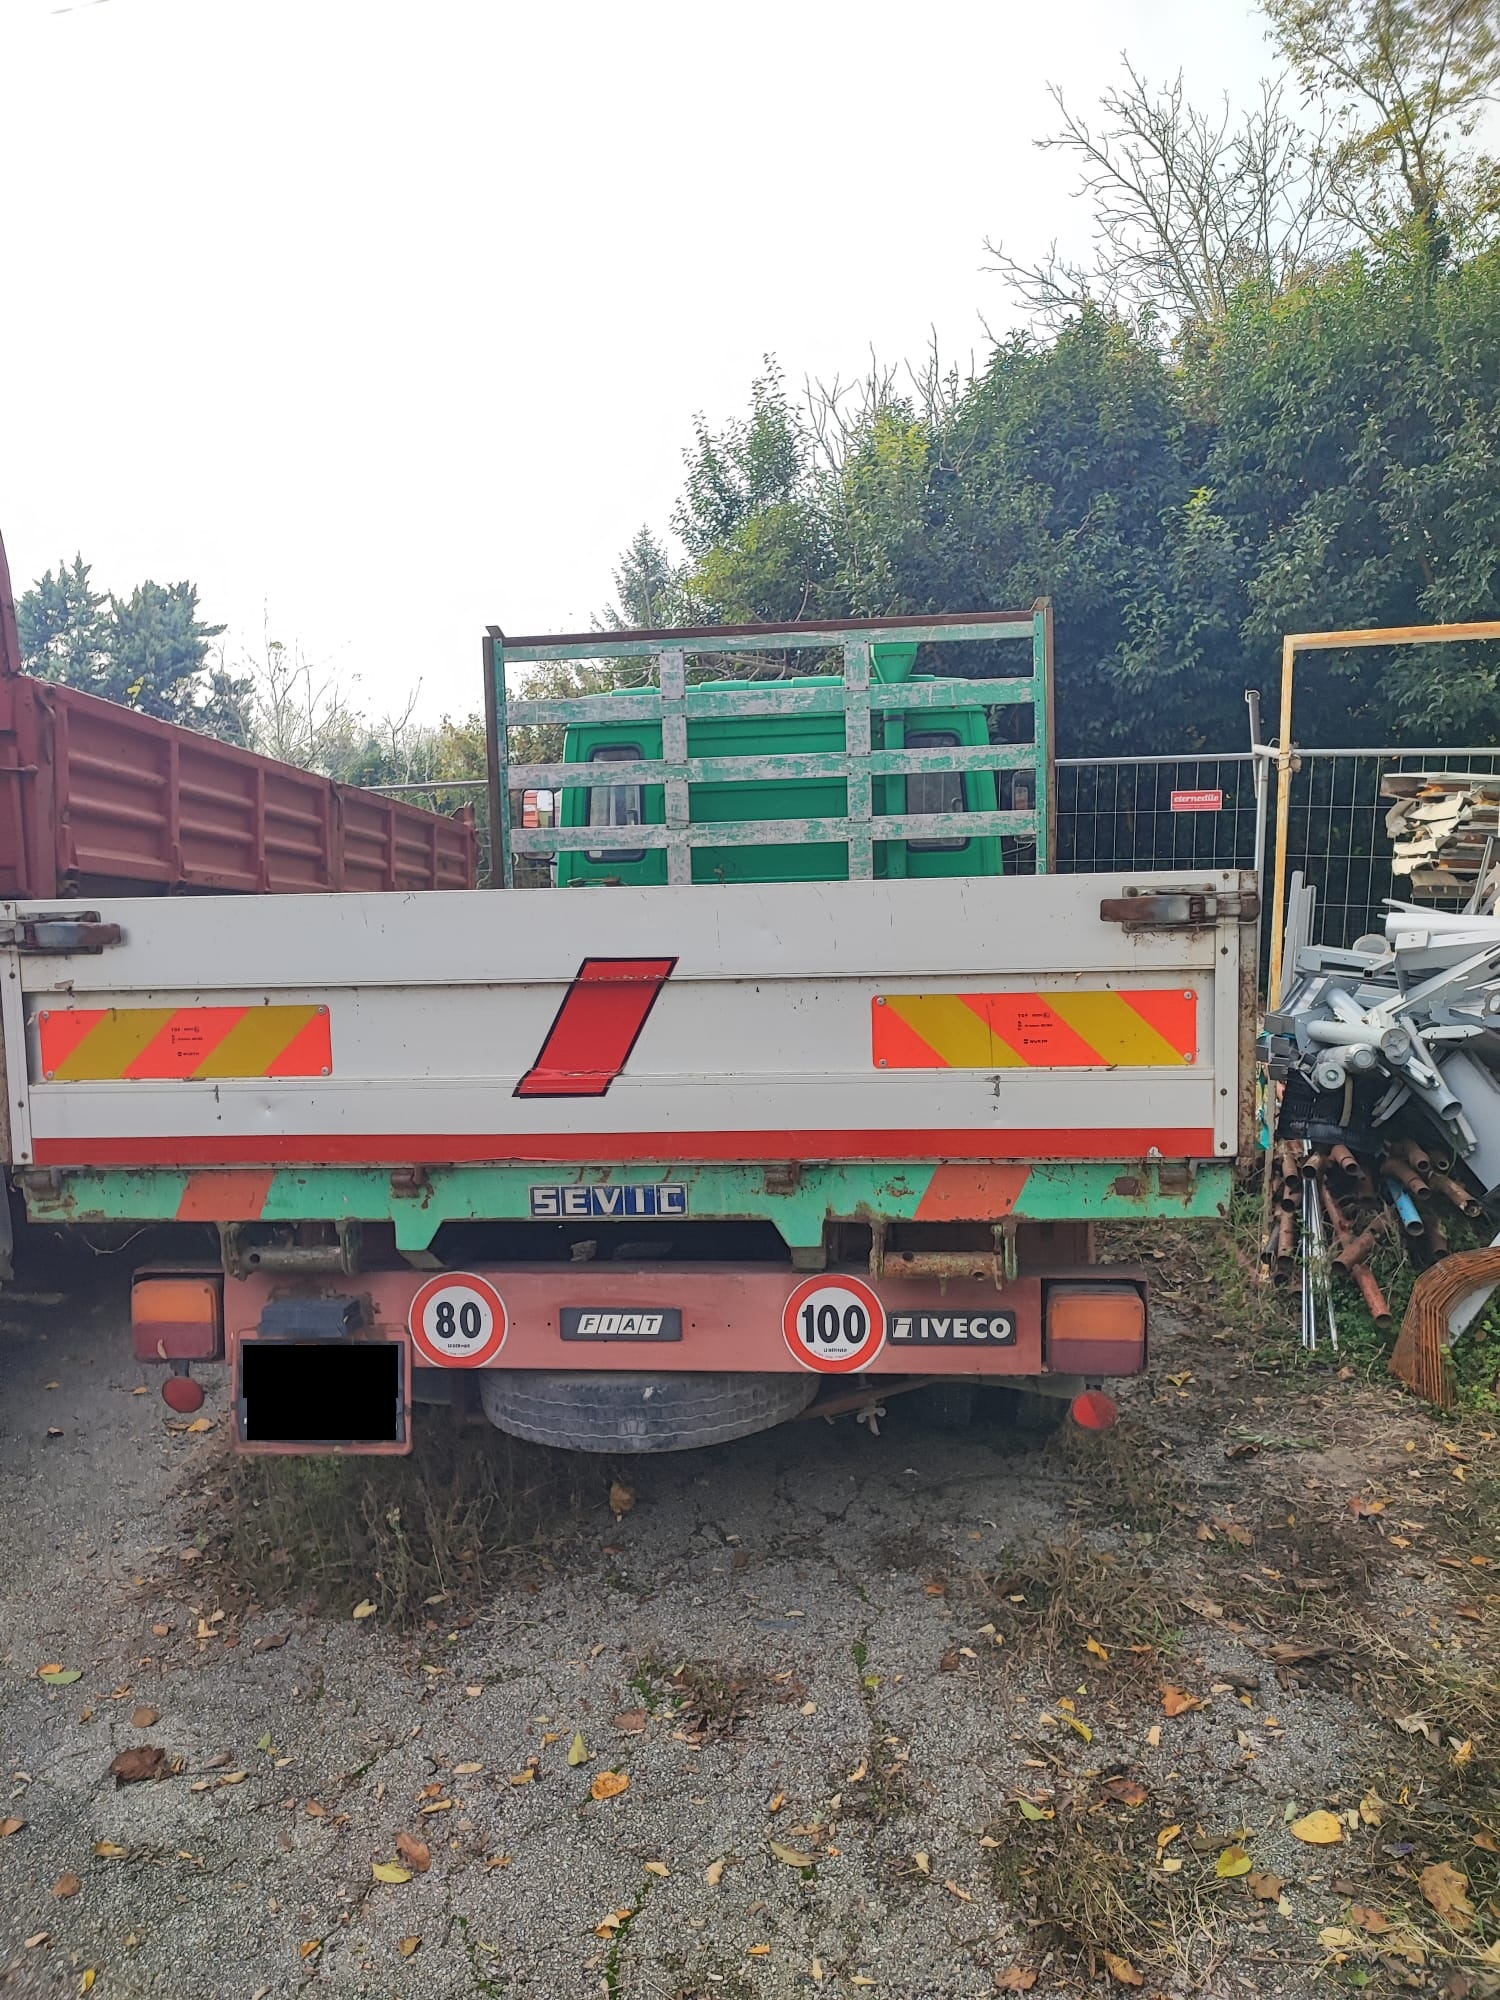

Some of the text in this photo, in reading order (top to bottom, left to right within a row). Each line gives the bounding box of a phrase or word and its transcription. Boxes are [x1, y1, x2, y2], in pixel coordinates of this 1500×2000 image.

[533, 1188, 682, 1214] SEVIC
[436, 1301, 482, 1339] 80
[580, 1316, 661, 1333] FIAT
[801, 1304, 866, 1344] 100
[920, 1317, 1011, 1339] IVECO
